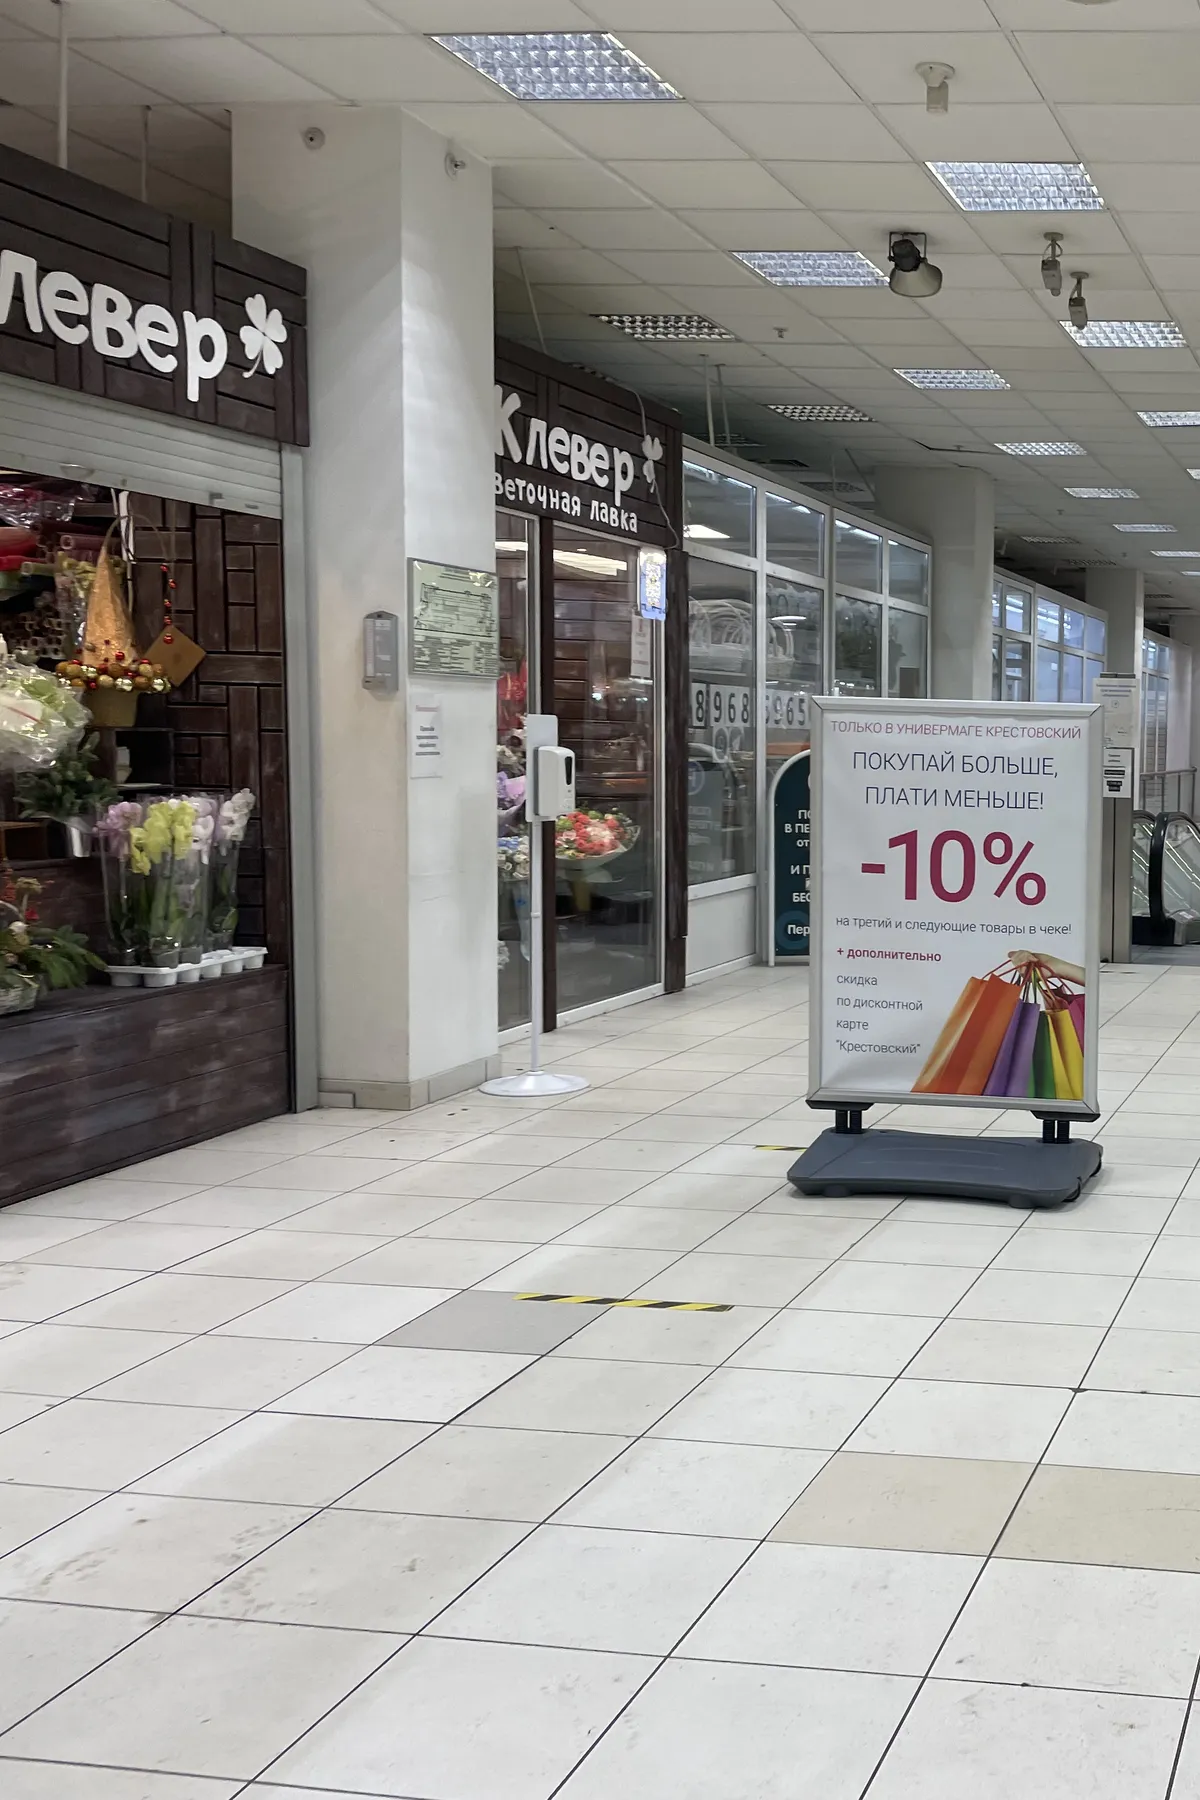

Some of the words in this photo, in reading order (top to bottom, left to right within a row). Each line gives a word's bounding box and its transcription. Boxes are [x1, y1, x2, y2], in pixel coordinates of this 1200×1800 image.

[495, 384, 634, 507] Клевер
[590, 500, 638, 533] лавка
[831, 720, 882, 734] ТОЛЬКО
[885, 722, 893, 734] В
[896, 723, 983, 737] УНИВЕРМАГЕ
[985, 726, 1081, 739] КРЕСТОВСКИЙ
[853, 750, 955, 772] ПОКУПАЙ
[962, 755, 1058, 779] БОЛЬШЕ,
[865, 786, 938, 807] ПЛАТИ
[944, 788, 1044, 810] МЕНЬШЕ!
[861, 829, 1047, 906] -10%
[836, 917, 850, 927] на
[852, 917, 892, 929] третий
[895, 920, 902, 929] и
[905, 920, 977, 934] следующие
[979, 923, 1026, 936] товары
[1029, 925, 1037, 934] в
[1040, 924, 1072, 935] чеке!
[847, 948, 942, 962] дополнительно
[836, 975, 878, 987] скидка
[836, 997, 851, 1007] по
[853, 998, 923, 1011] дисконтной
[836, 1019, 869, 1032] карте
[836, 1039, 921, 1054] "Крестовский"
